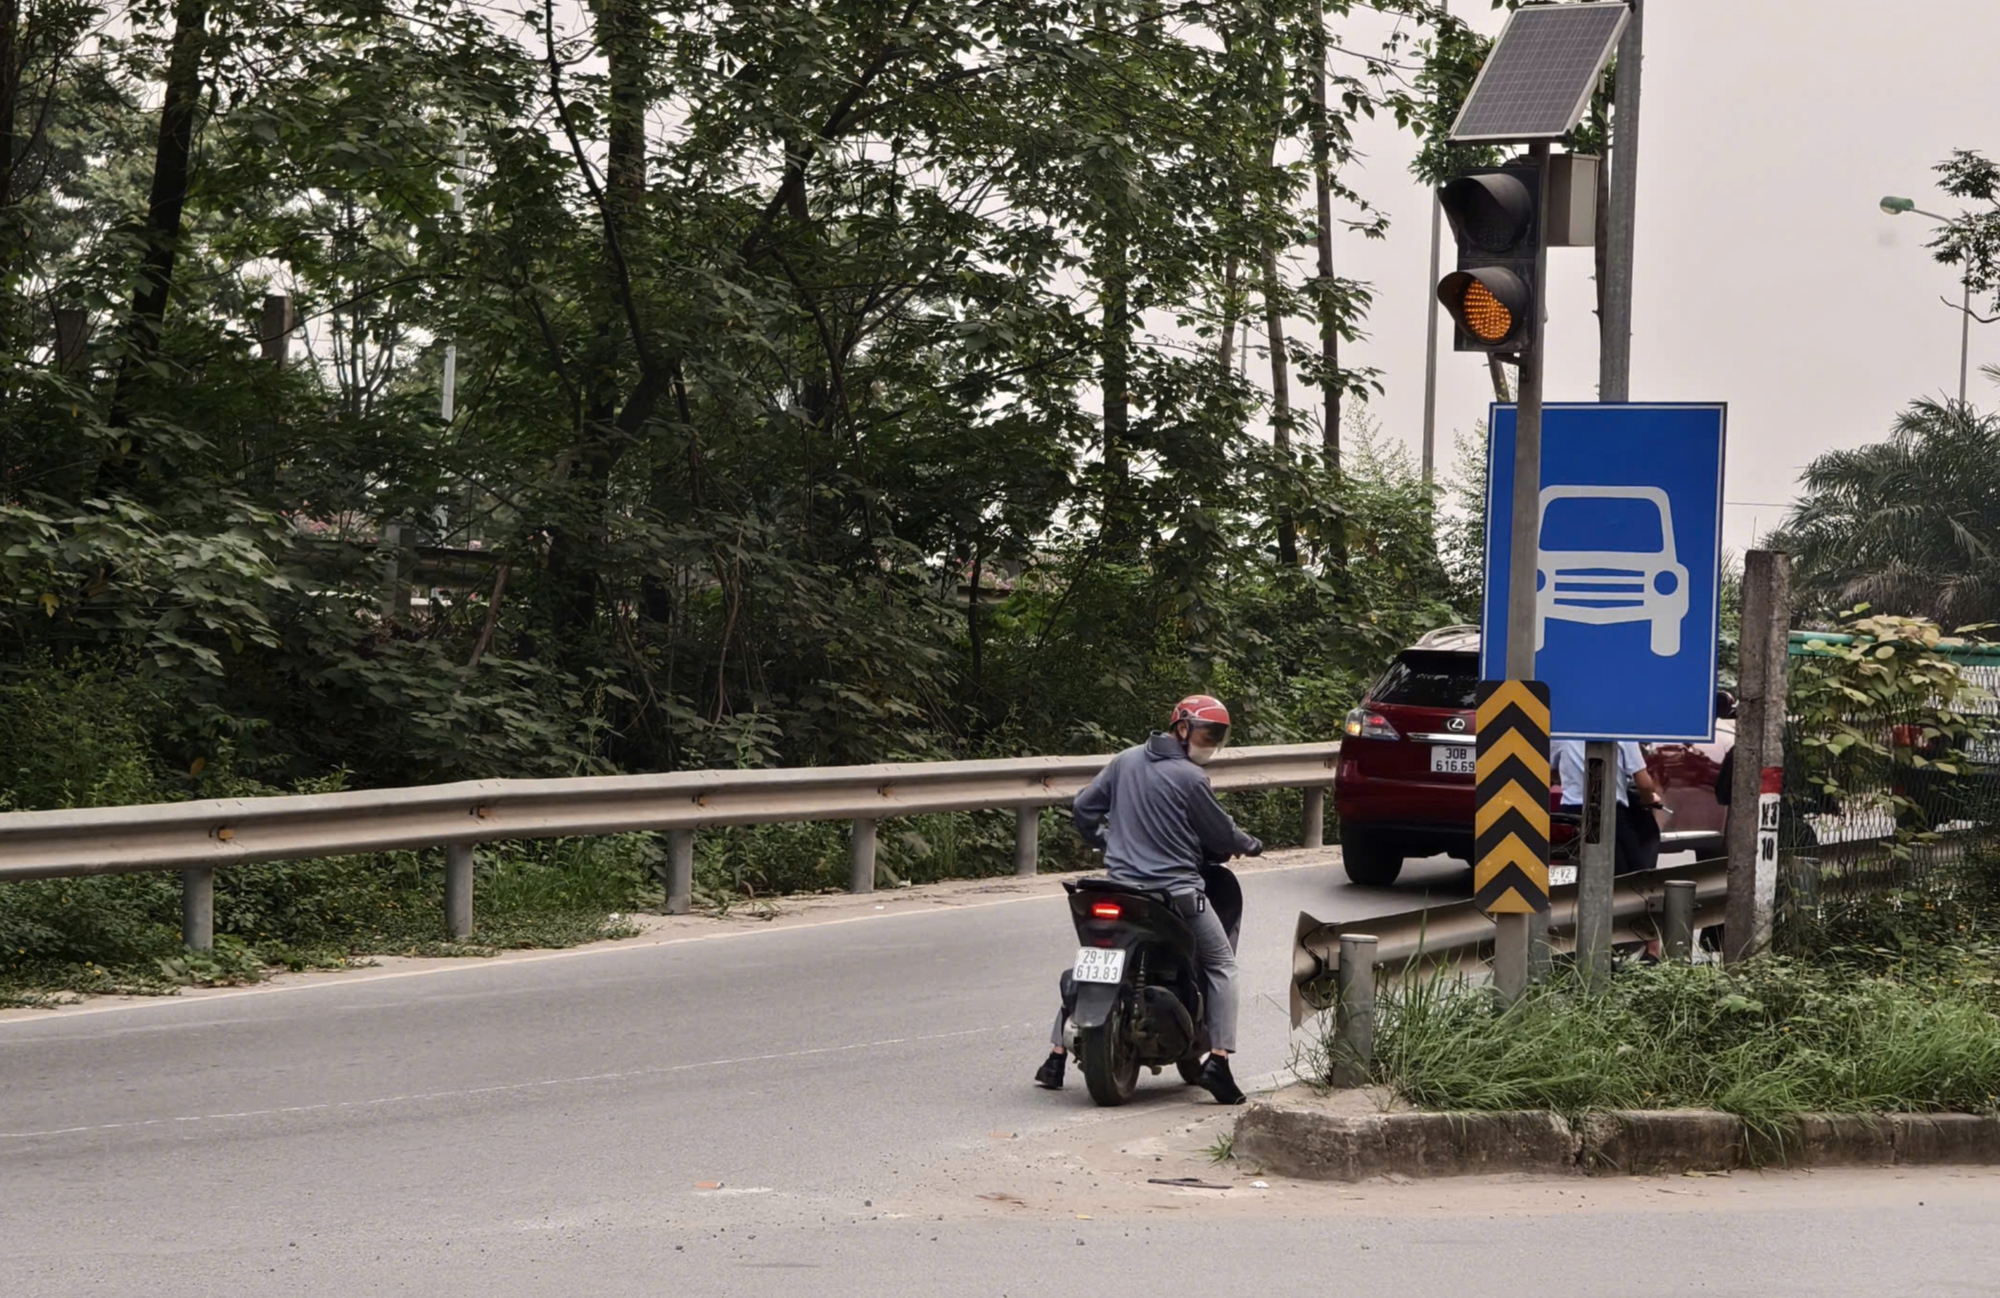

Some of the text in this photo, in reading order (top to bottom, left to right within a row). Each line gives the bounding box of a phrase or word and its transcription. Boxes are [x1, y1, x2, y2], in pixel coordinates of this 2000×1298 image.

[1445, 748, 1467, 760] 30B
[1436, 760, 1475, 772] 616.69
[1761, 838, 1774, 861] 10
[1083, 950, 1117, 965] 29-V7
[1076, 964, 1118, 981] 613.83
